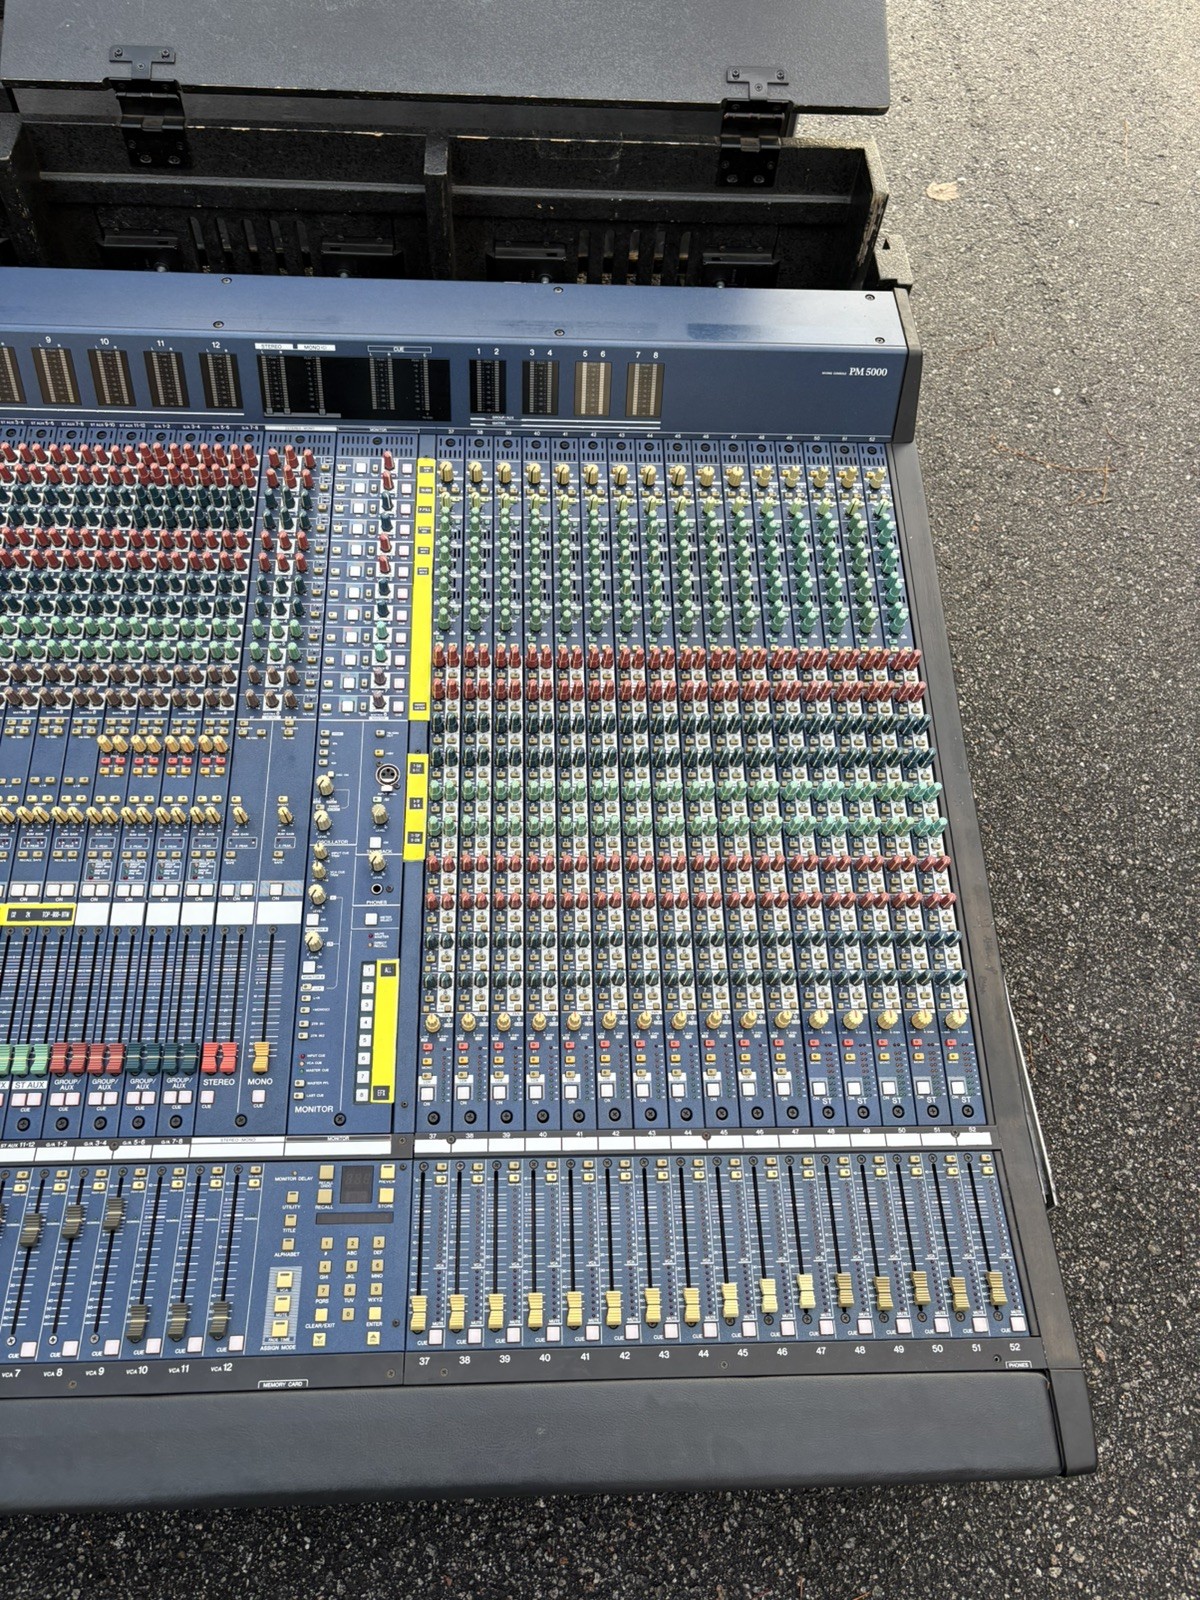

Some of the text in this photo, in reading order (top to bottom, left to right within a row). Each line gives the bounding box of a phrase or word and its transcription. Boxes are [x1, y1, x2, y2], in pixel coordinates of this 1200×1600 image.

[849, 367, 864, 376] PM
[865, 368, 888, 376] 5000
[166, 1077, 193, 1085] GROUP/
[777, 1347, 788, 1356] 46
[816, 1346, 826, 1355] 47
[854, 1346, 866, 1354] 48
[894, 1345, 904, 1353] 49
[932, 1344, 943, 1353] 50
[972, 1344, 981, 1352] 51
[1010, 1343, 1021, 1351] 52
[619, 1351, 630, 1360] 42
[659, 1350, 670, 1359] 43
[737, 1348, 748, 1357] 45
[419, 1357, 430, 1366] 37
[459, 1356, 470, 1364] 38
[499, 1354, 510, 1363] 39
[539, 1353, 551, 1362] 40
[98, 1367, 104, 1376] 9
[138, 1365, 148, 1374] 10
[181, 1364, 189, 1373] 11
[223, 1363, 233, 1371] 12
[15, 1369, 21, 1377] 7
[56, 1368, 63, 1376] 8
